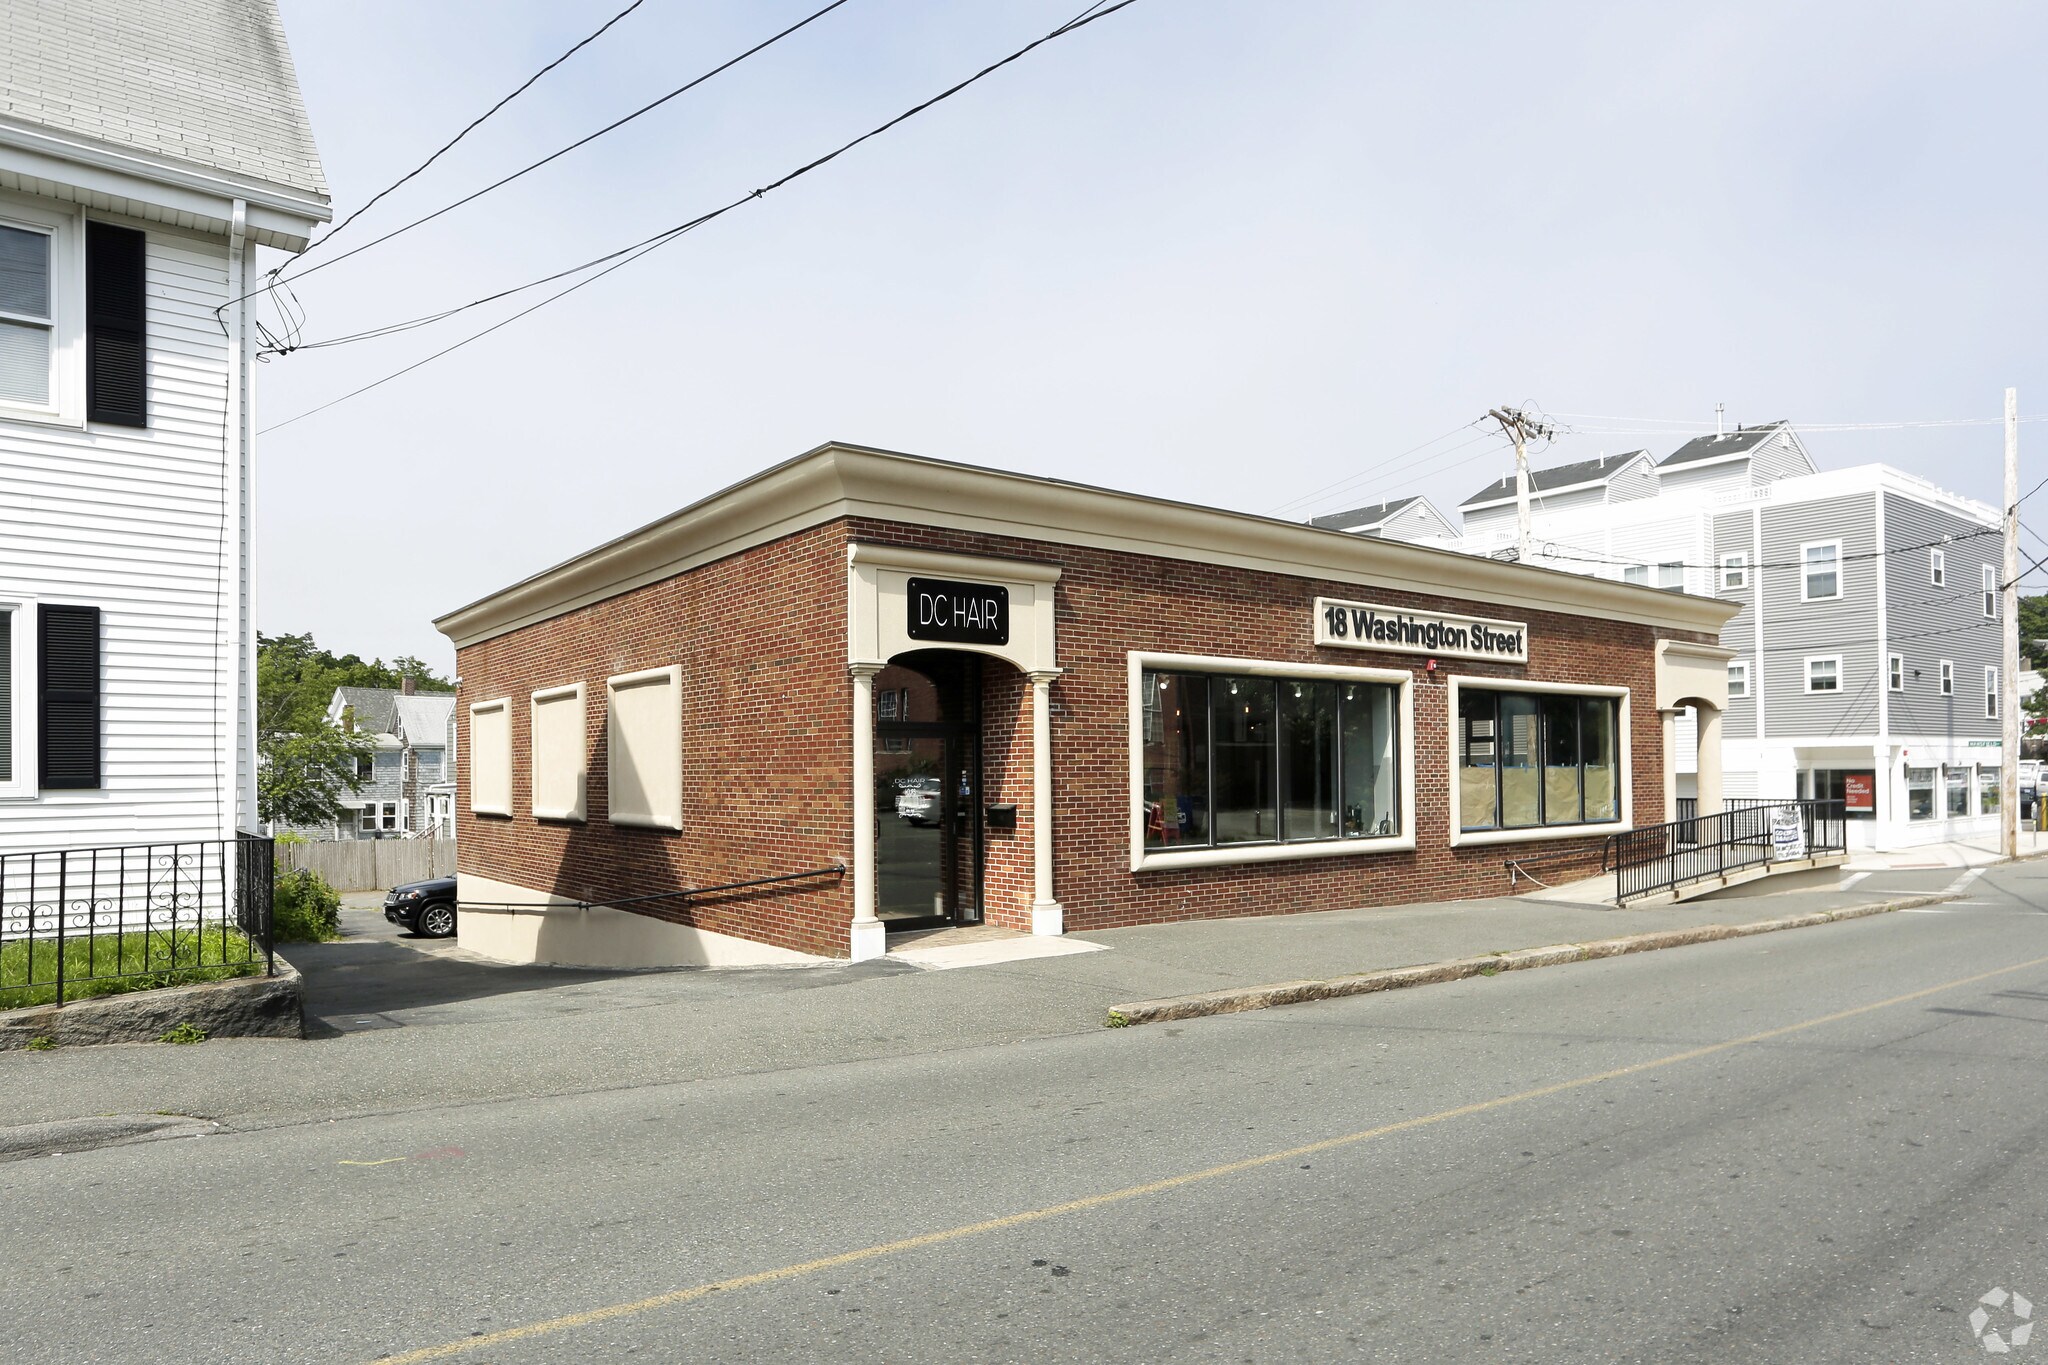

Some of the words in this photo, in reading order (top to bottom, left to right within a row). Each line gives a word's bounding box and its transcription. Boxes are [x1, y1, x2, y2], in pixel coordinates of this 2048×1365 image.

[920, 593, 948, 627] DC
[953, 596, 998, 630] HAIR
[1325, 606, 1348, 637] 18
[1351, 609, 1468, 650] Washington
[1470, 624, 1523, 654] Street
